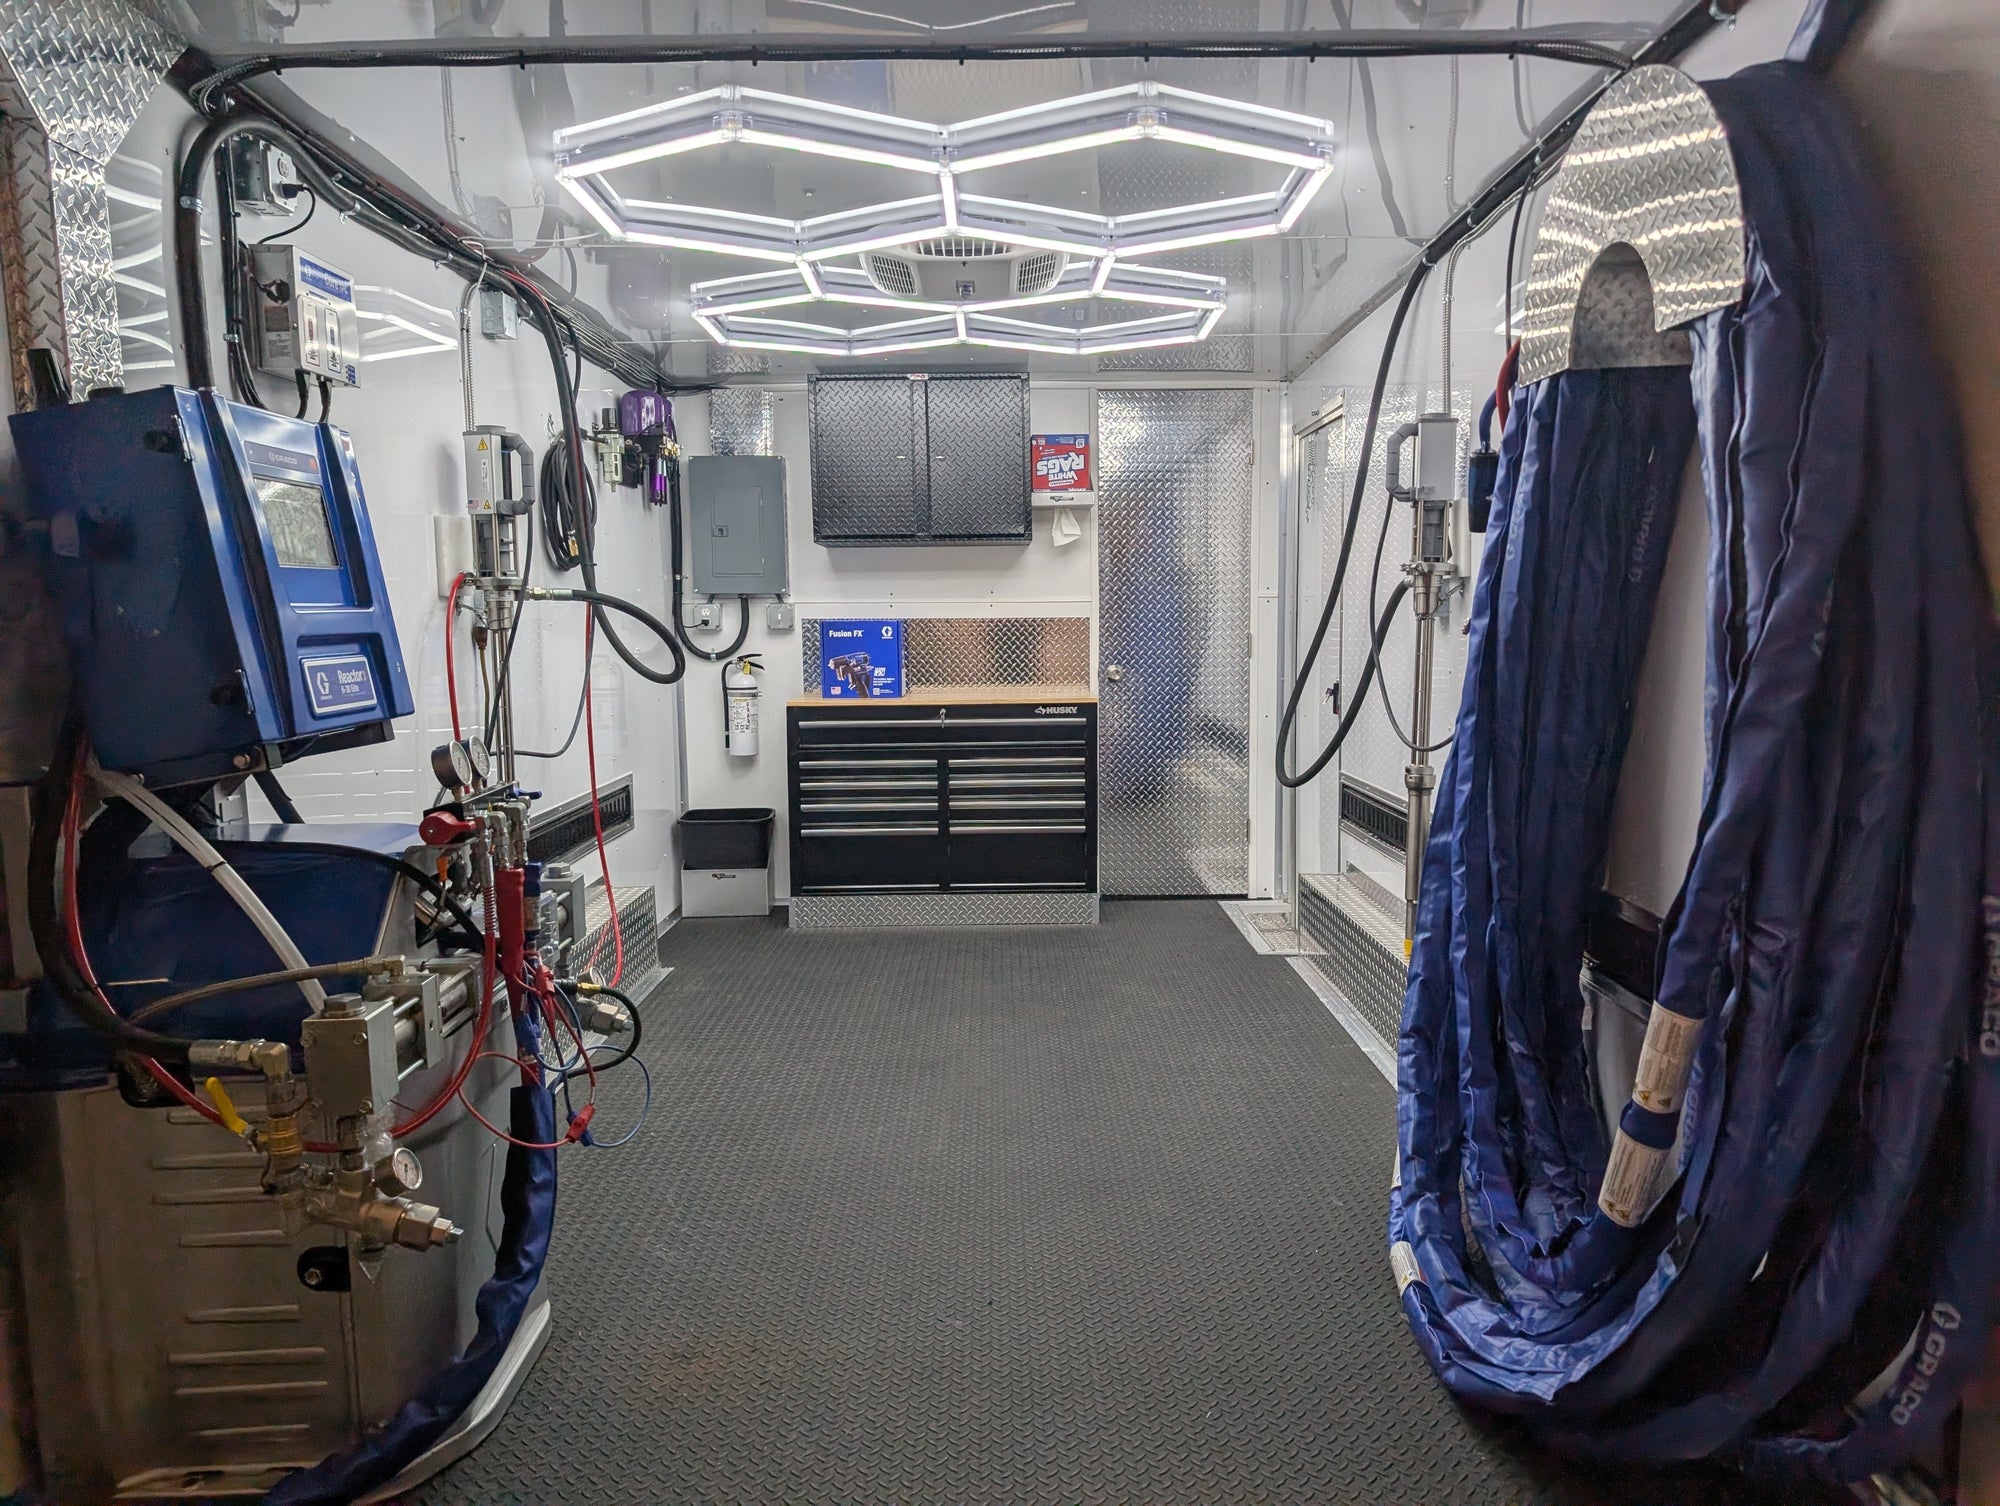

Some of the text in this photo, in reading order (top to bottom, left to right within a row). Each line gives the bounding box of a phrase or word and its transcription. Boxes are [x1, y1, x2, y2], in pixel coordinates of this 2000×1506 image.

[1036, 452, 1084, 475] RAGS
[1048, 470, 1078, 481] WHITE
[828, 629, 852, 638] Fusion
[337, 669, 362, 684] Reactor
[1046, 706, 1078, 714] HUSKY
[1889, 1331, 1946, 1426] GRACO
